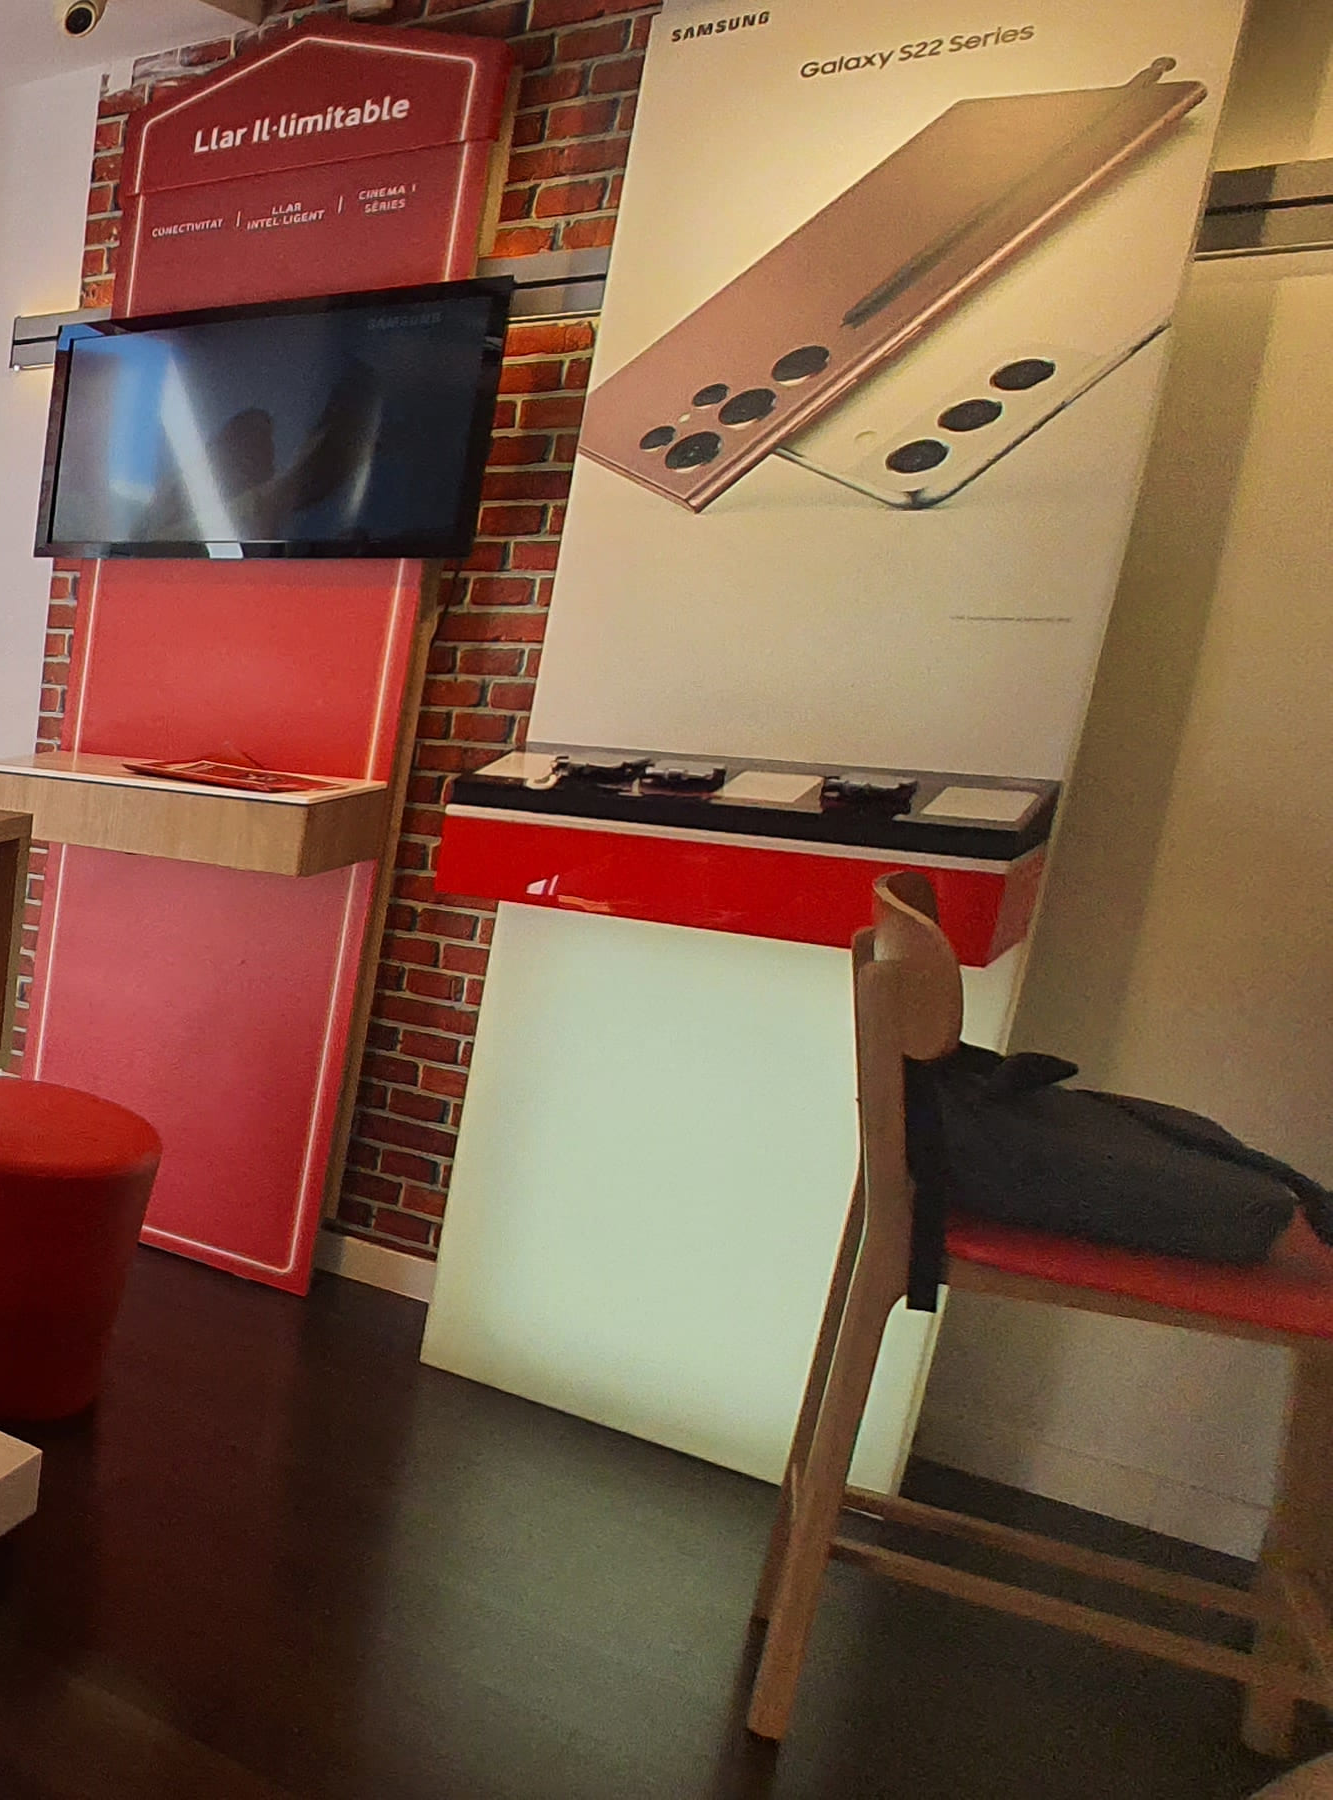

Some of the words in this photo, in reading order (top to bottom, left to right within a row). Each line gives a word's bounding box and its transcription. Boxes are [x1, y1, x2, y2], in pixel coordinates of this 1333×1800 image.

[671, 10, 771, 43] SAMSUNG
[799, 48, 895, 80] Galaxy
[897, 38, 945, 63] S22
[948, 24, 1036, 53] Series
[193, 125, 249, 154] Llar
[358, 184, 406, 201] CINEMA
[271, 202, 303, 216] LLAR
